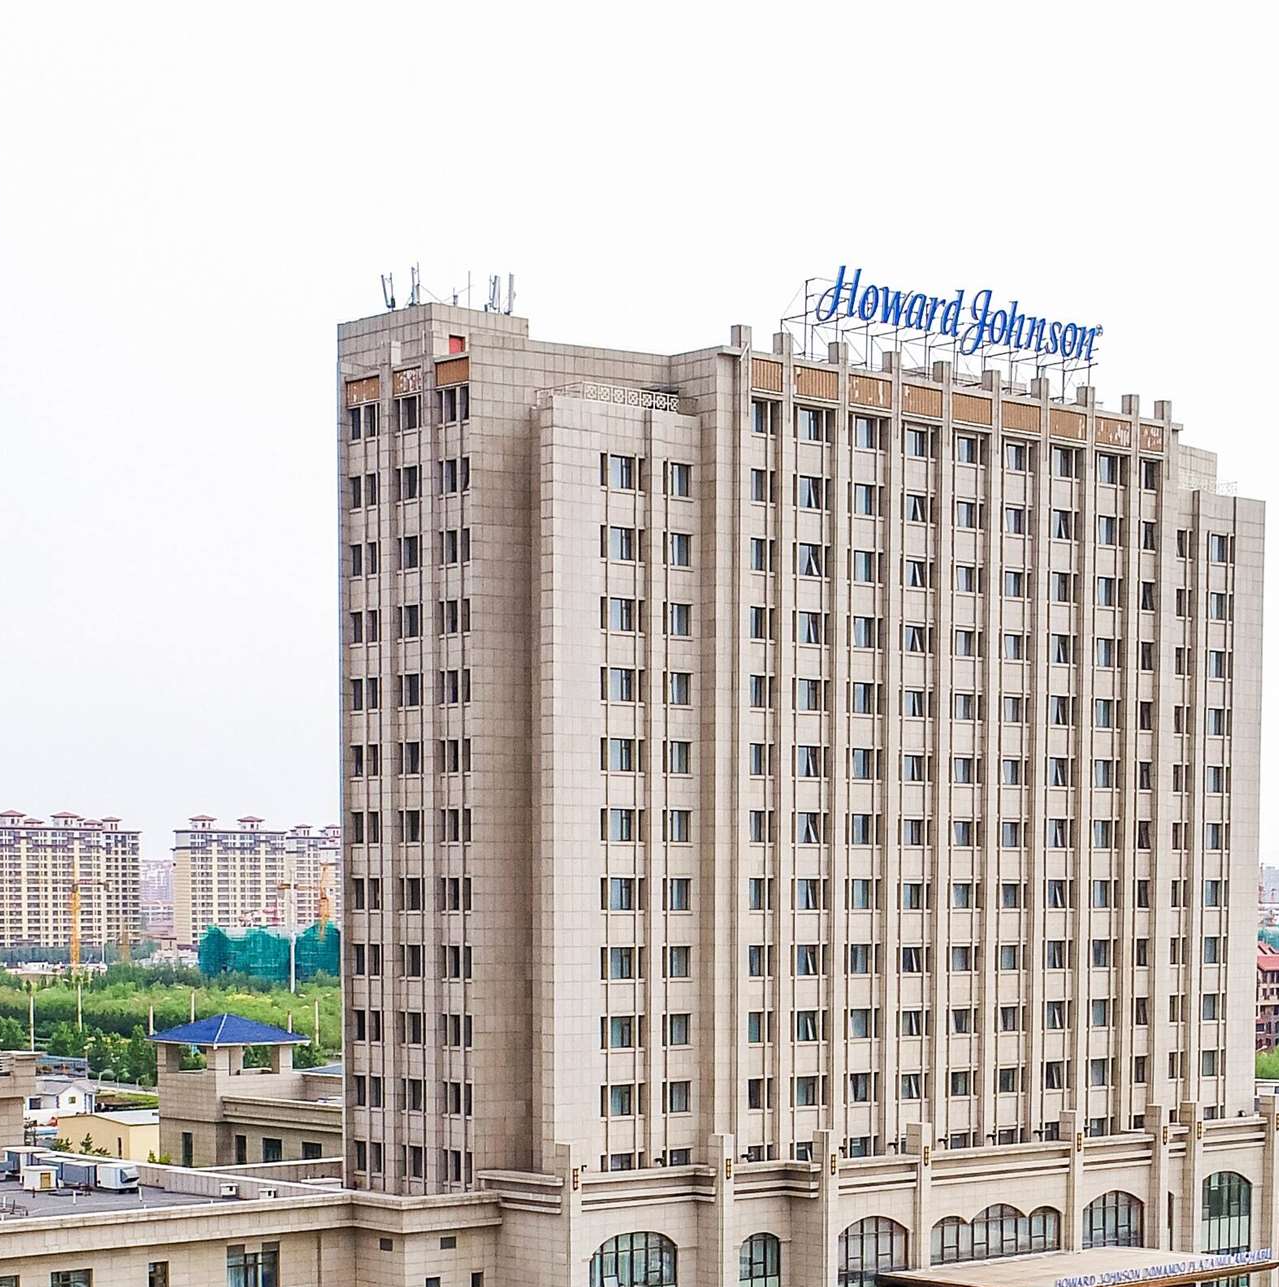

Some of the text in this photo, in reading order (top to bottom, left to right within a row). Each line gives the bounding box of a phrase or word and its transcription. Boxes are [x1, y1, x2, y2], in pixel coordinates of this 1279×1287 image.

[816, 265, 1097, 360] Howard Johnson
[1097, 1267, 1140, 1285] JOHNSON
